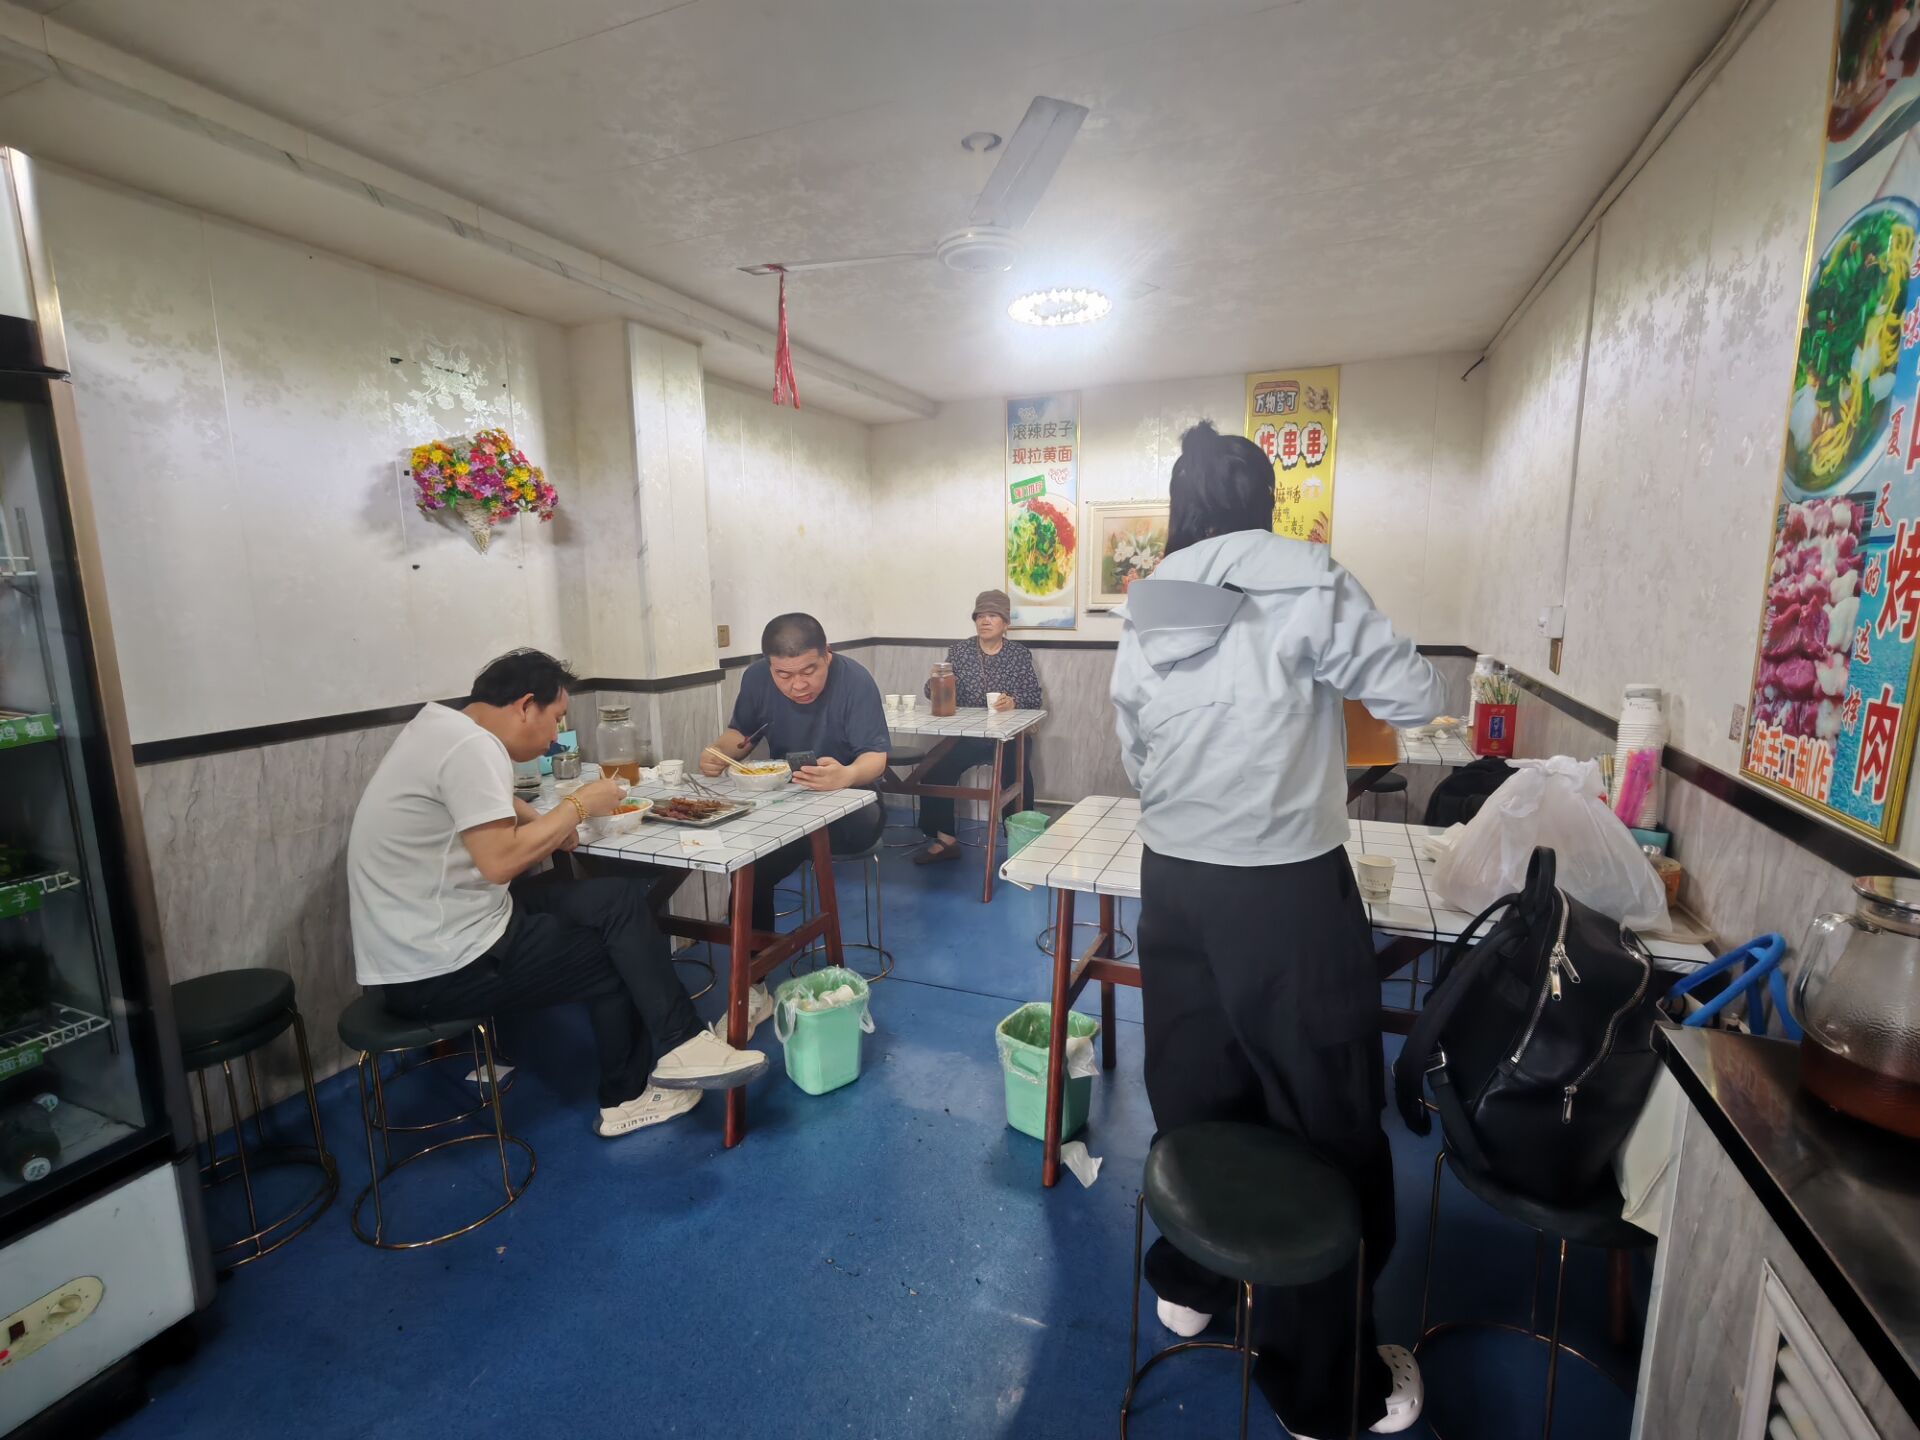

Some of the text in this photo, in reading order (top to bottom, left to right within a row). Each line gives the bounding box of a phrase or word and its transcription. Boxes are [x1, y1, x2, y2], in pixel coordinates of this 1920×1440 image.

[1256, 391, 1297, 413] 万物皆可
[1012, 420, 1072, 440] 滚辣皮子
[1260, 427, 1321, 459] 炸串串
[1012, 445, 1072, 464] 现拉黄面
[1853, 372, 1920, 803] 烤肉
